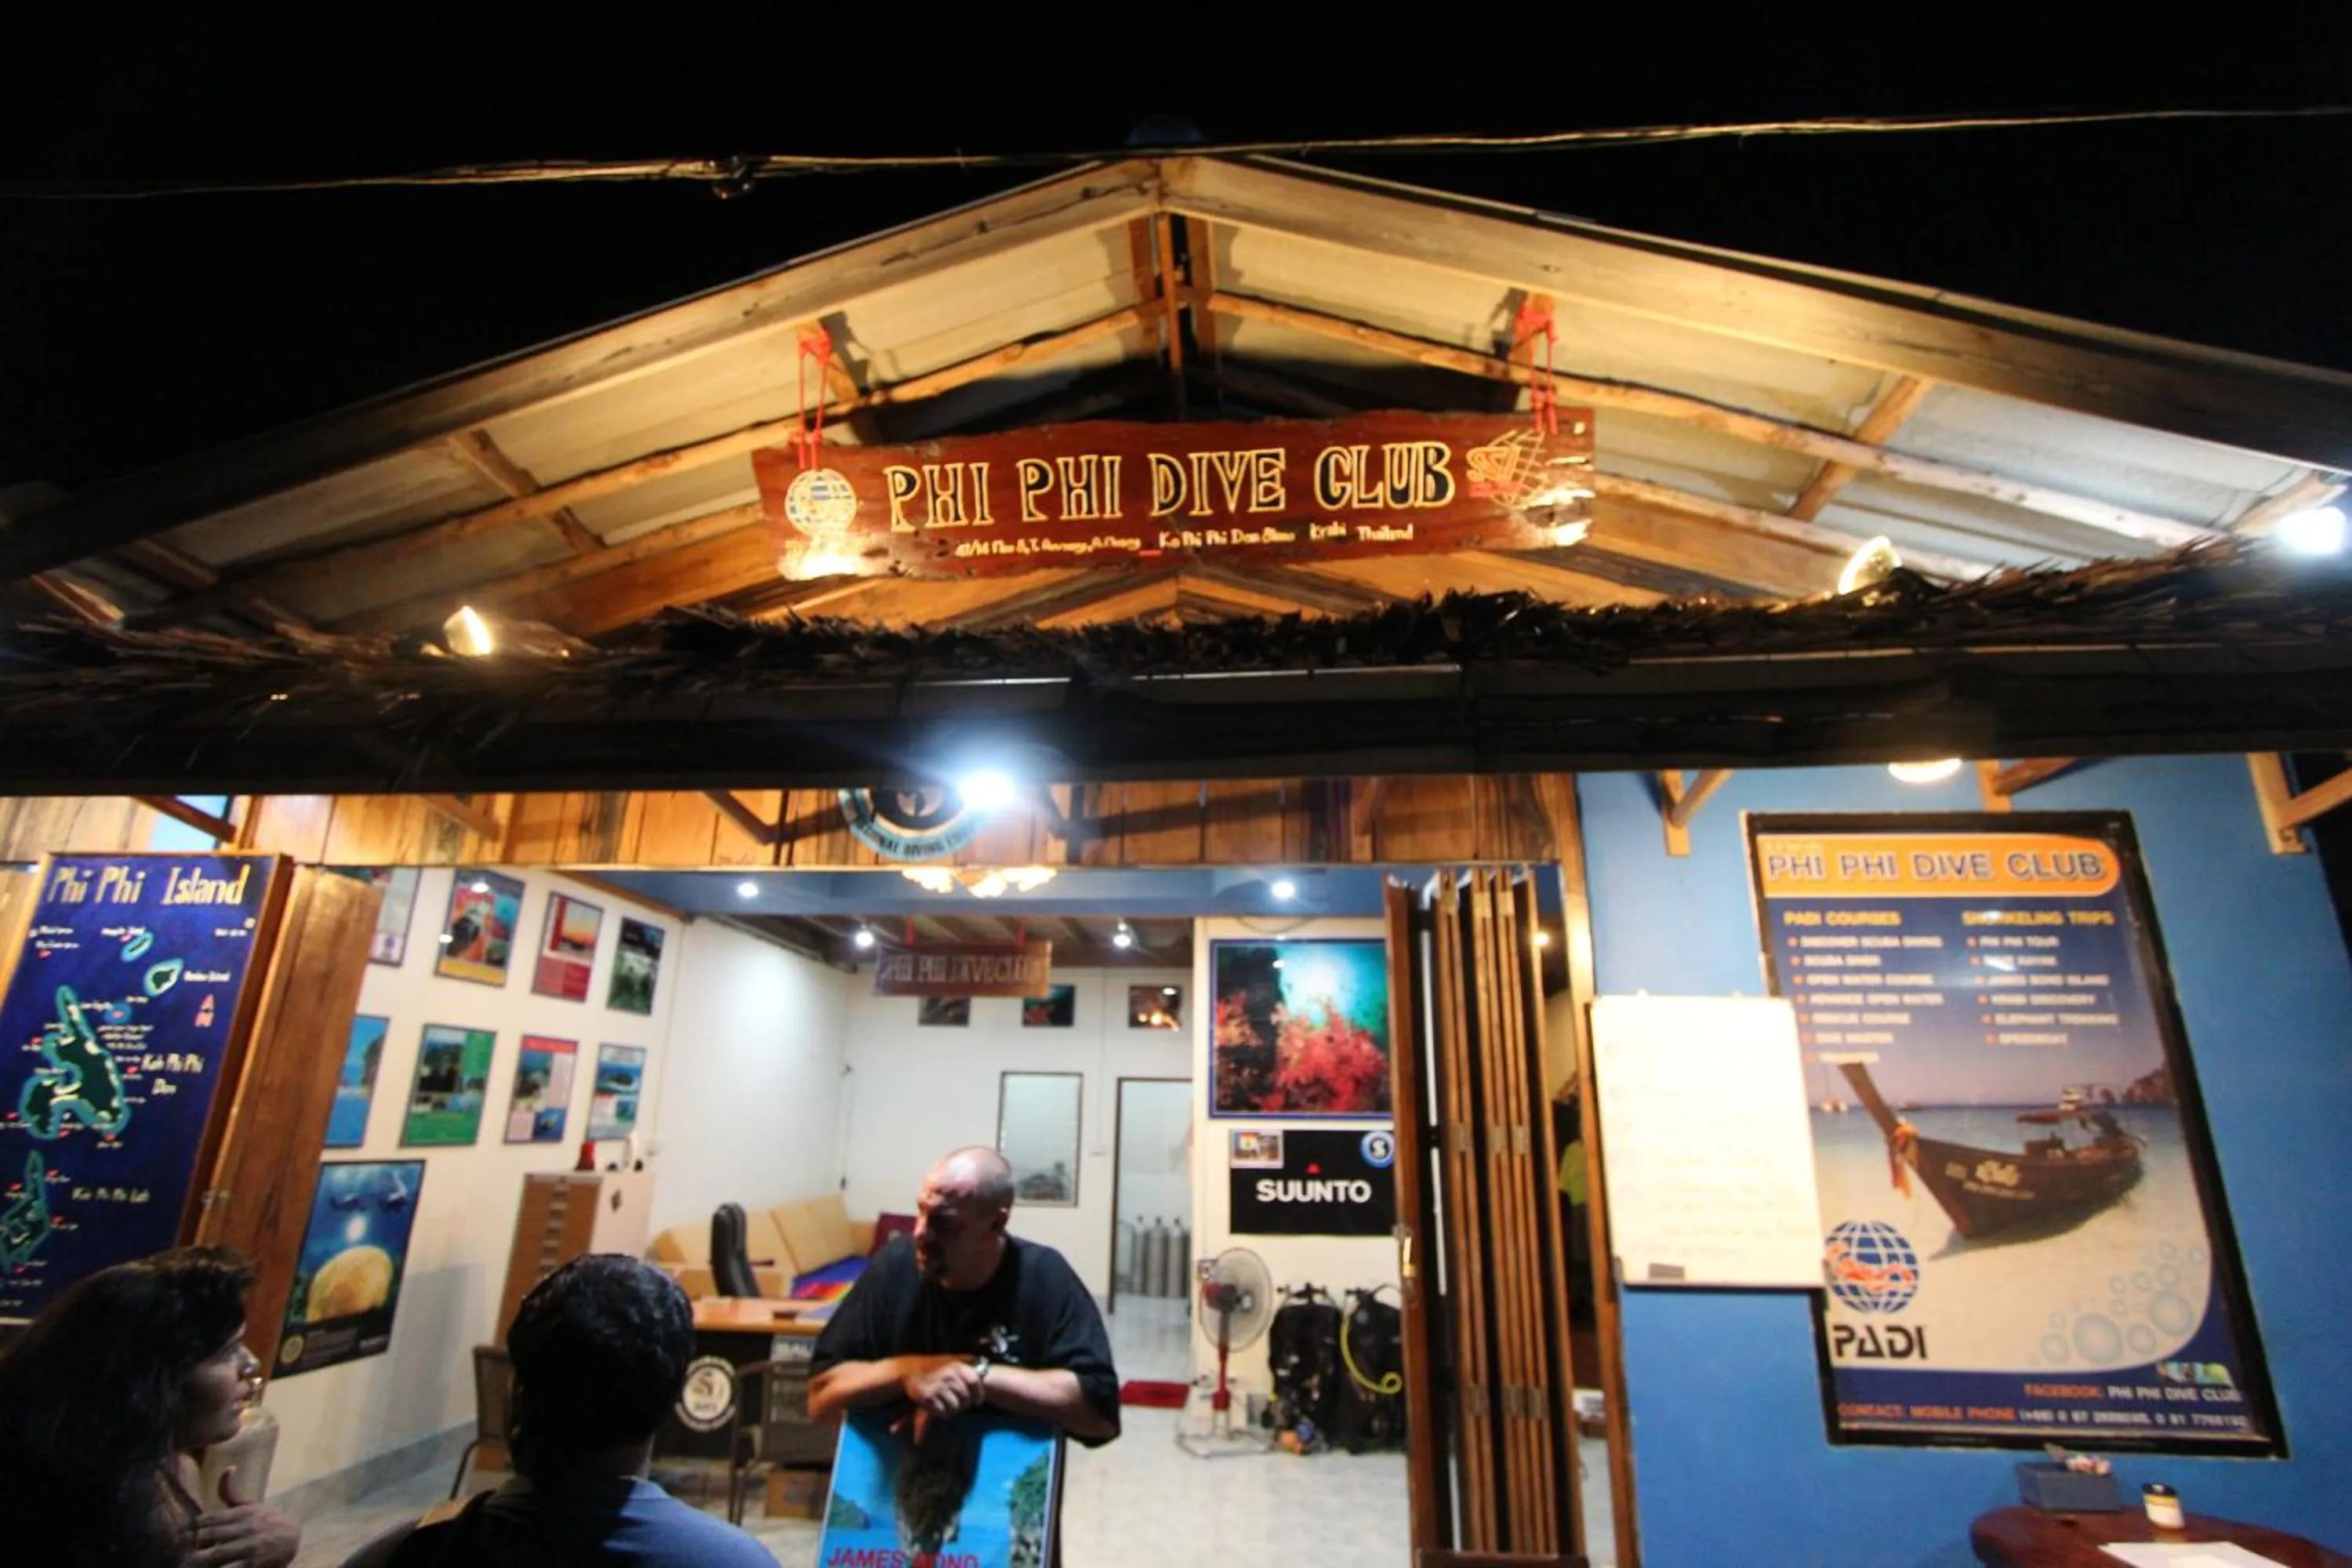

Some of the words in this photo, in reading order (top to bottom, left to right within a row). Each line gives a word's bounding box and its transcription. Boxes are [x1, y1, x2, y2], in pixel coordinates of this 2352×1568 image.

[884, 462, 995, 532] PHI
[1016, 455, 1123, 521] PHI
[1147, 448, 1287, 516] DIVE
[1314, 441, 1455, 510] CLUB
[1767, 852, 1825, 880] PHI
[1839, 852, 1897, 880] PHI
[1911, 851, 1992, 880] DIVE
[2006, 851, 2106, 880] CLUB
[48, 866, 93, 903] Phi
[95, 865, 146, 903] Phi
[162, 864, 250, 906] Island
[1256, 1179, 1371, 1203] SUUNTO
[1833, 1324, 1928, 1359] PADI
[827, 1546, 906, 1568] JAMES
